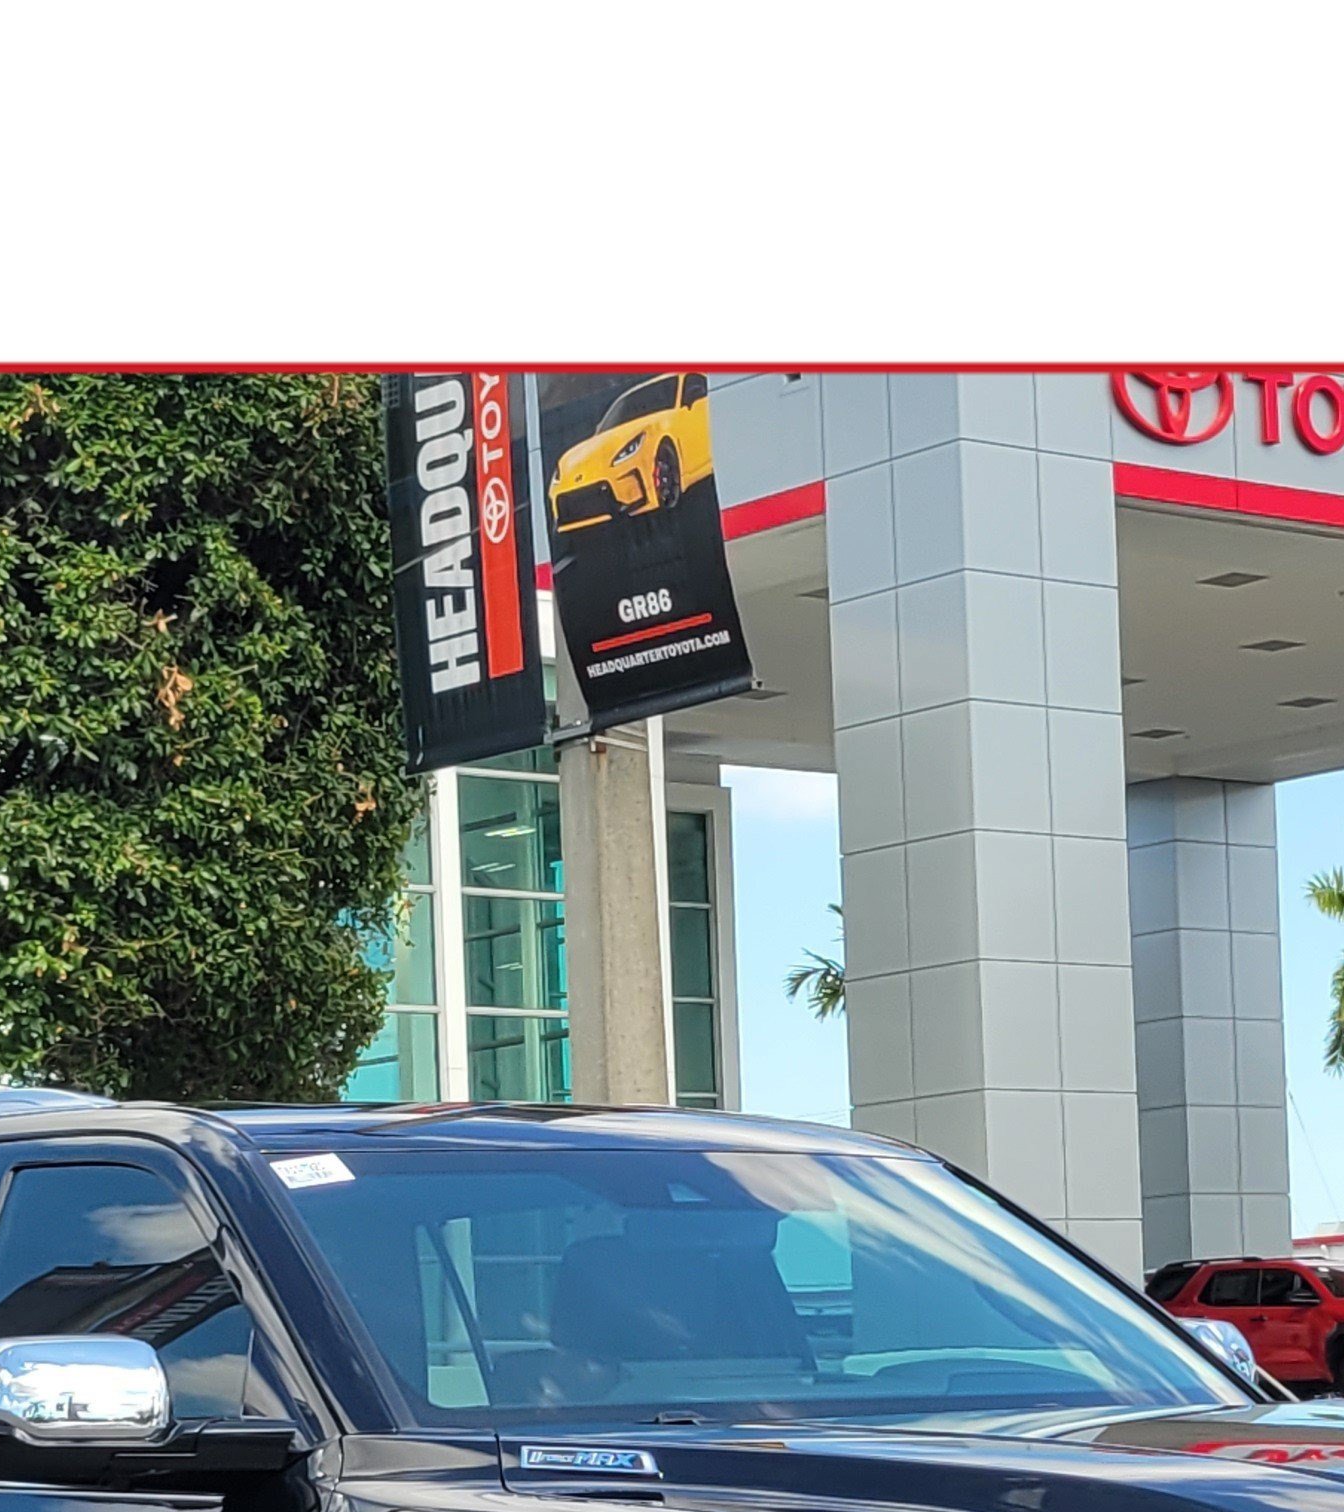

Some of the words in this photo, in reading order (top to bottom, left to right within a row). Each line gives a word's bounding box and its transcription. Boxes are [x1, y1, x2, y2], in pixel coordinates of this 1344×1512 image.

[414, 373, 481, 694] HEADQU
[618, 588, 673, 623] GR86
[586, 630, 731, 678] HEADQUARTERTOYOTA.COM
